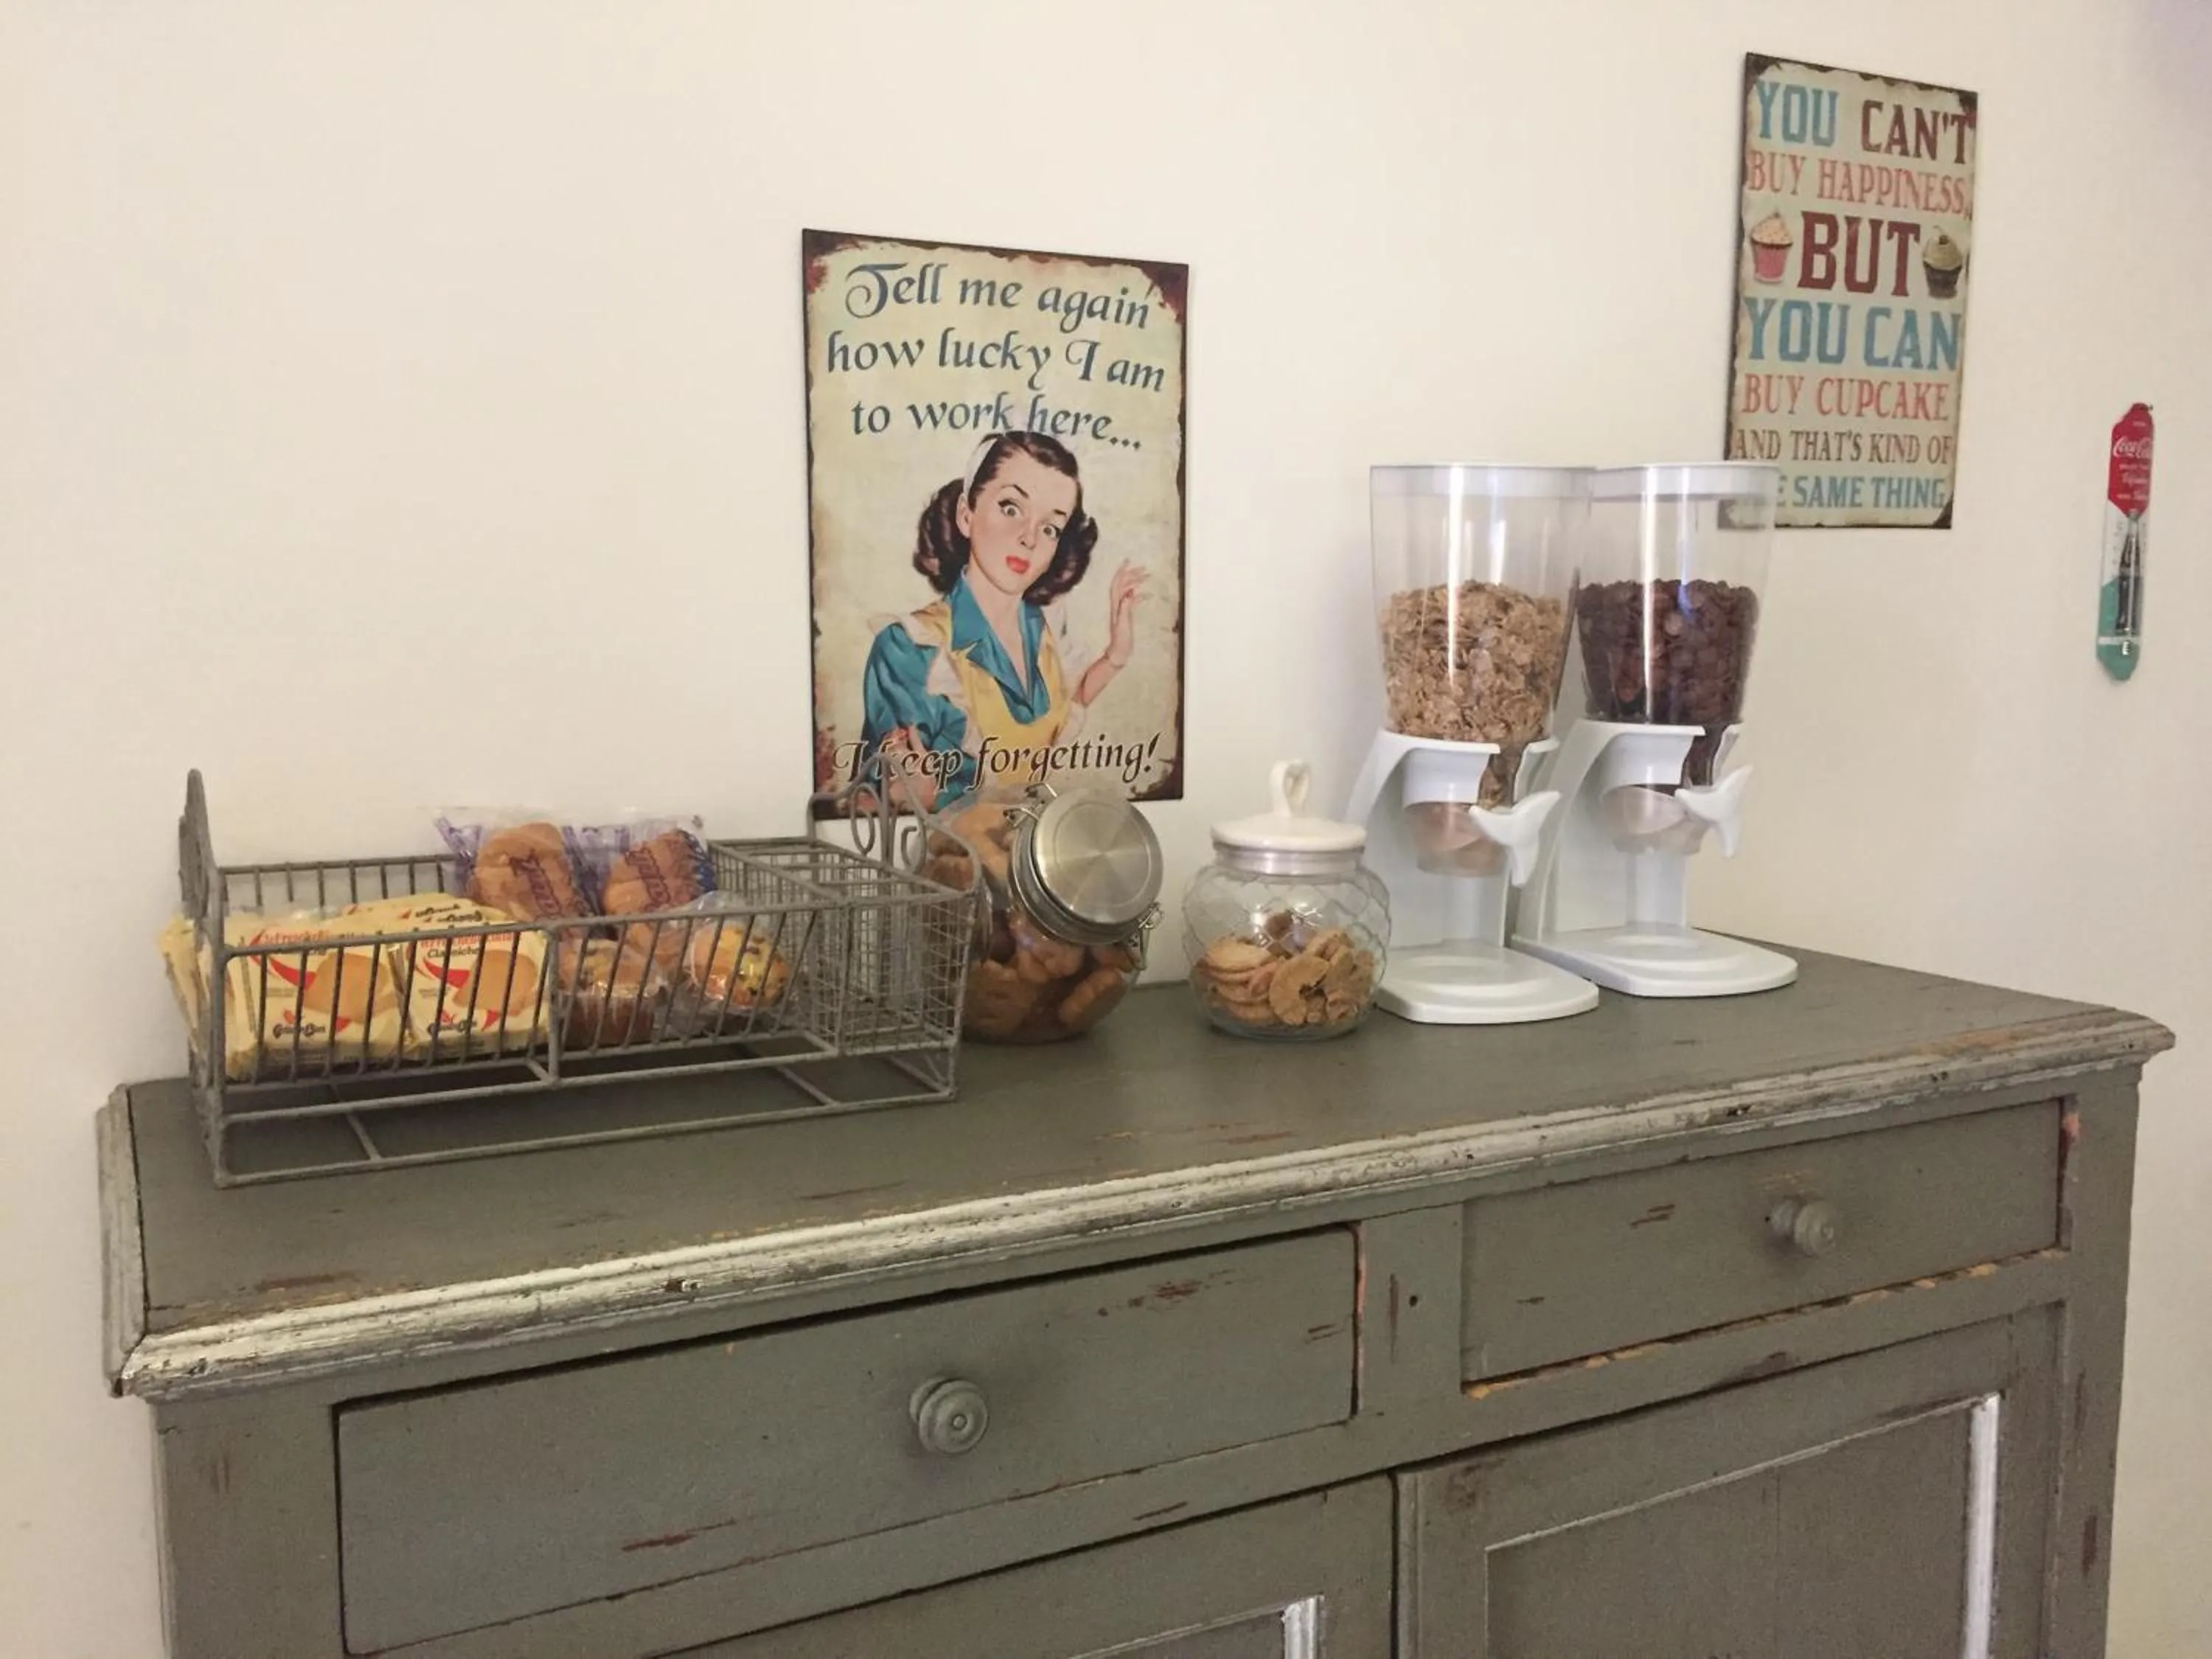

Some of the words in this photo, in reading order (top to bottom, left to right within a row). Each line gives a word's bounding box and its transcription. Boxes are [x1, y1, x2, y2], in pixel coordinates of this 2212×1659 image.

[1753, 79, 1839, 148] YOU
[1860, 99, 1974, 165] CAN'T
[1746, 149, 1806, 196] BUY
[1797, 210, 1921, 297] BUT
[845, 262, 948, 319] Tell
[959, 276, 1023, 307] me
[1037, 286, 1150, 334] again
[827, 330, 925, 373] how
[938, 327, 1051, 391] lucky
[1065, 339, 1102, 381] I
[1107, 358, 1165, 392] am
[1743, 296, 1851, 365] YOU
[1863, 306, 1962, 372] CAN
[852, 400, 891, 435] to
[906, 391, 1016, 432] work
[1026, 393, 1142, 451] here...
[1741, 372, 1805, 415] BUY
[1816, 377, 1950, 421] CUPCAKE
[1733, 428, 1781, 460] AND
[1790, 428, 1863, 462] THAT'S
[1868, 432, 1921, 465] KIND
[1927, 434, 1953, 465] OF
[1792, 474, 1865, 509] SAME
[1871, 476, 1946, 509] THING
[832, 740, 869, 782] I
[967, 730, 1166, 791] forgetting!
